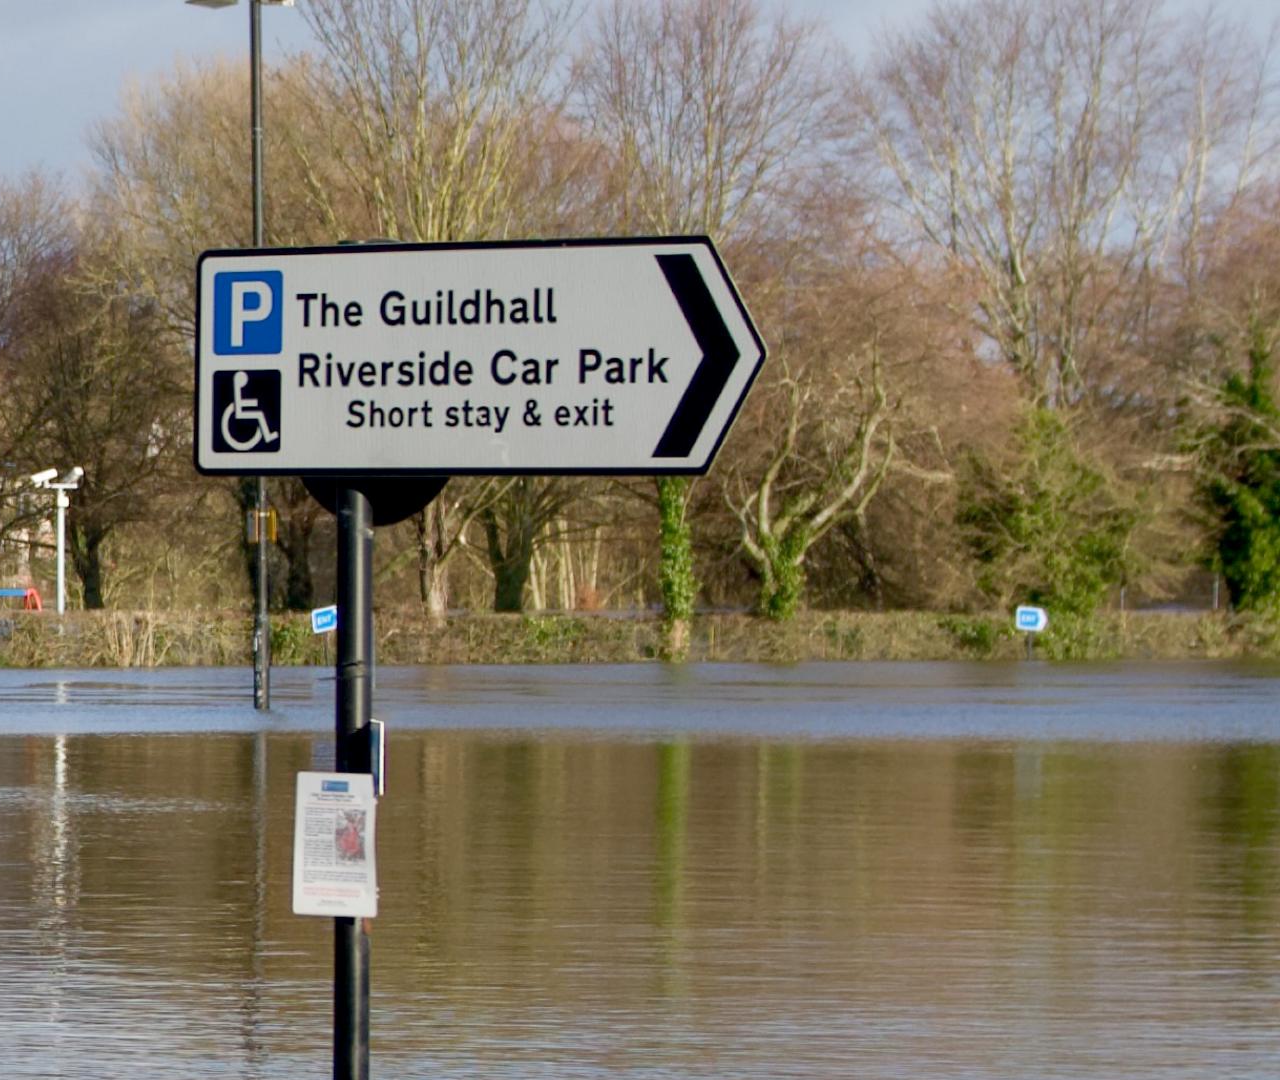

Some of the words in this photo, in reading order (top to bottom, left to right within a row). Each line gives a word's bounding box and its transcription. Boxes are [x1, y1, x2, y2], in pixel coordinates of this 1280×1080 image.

[230, 281, 272, 347] P
[295, 292, 363, 328] The
[379, 287, 558, 327] Guildhall
[298, 350, 474, 388] Riverside
[490, 349, 560, 386] Car
[578, 347, 670, 385] Park
[345, 399, 433, 429] Short
[444, 399, 510, 434] stay
[522, 398, 542, 427] &
[554, 397, 615, 427] exit
